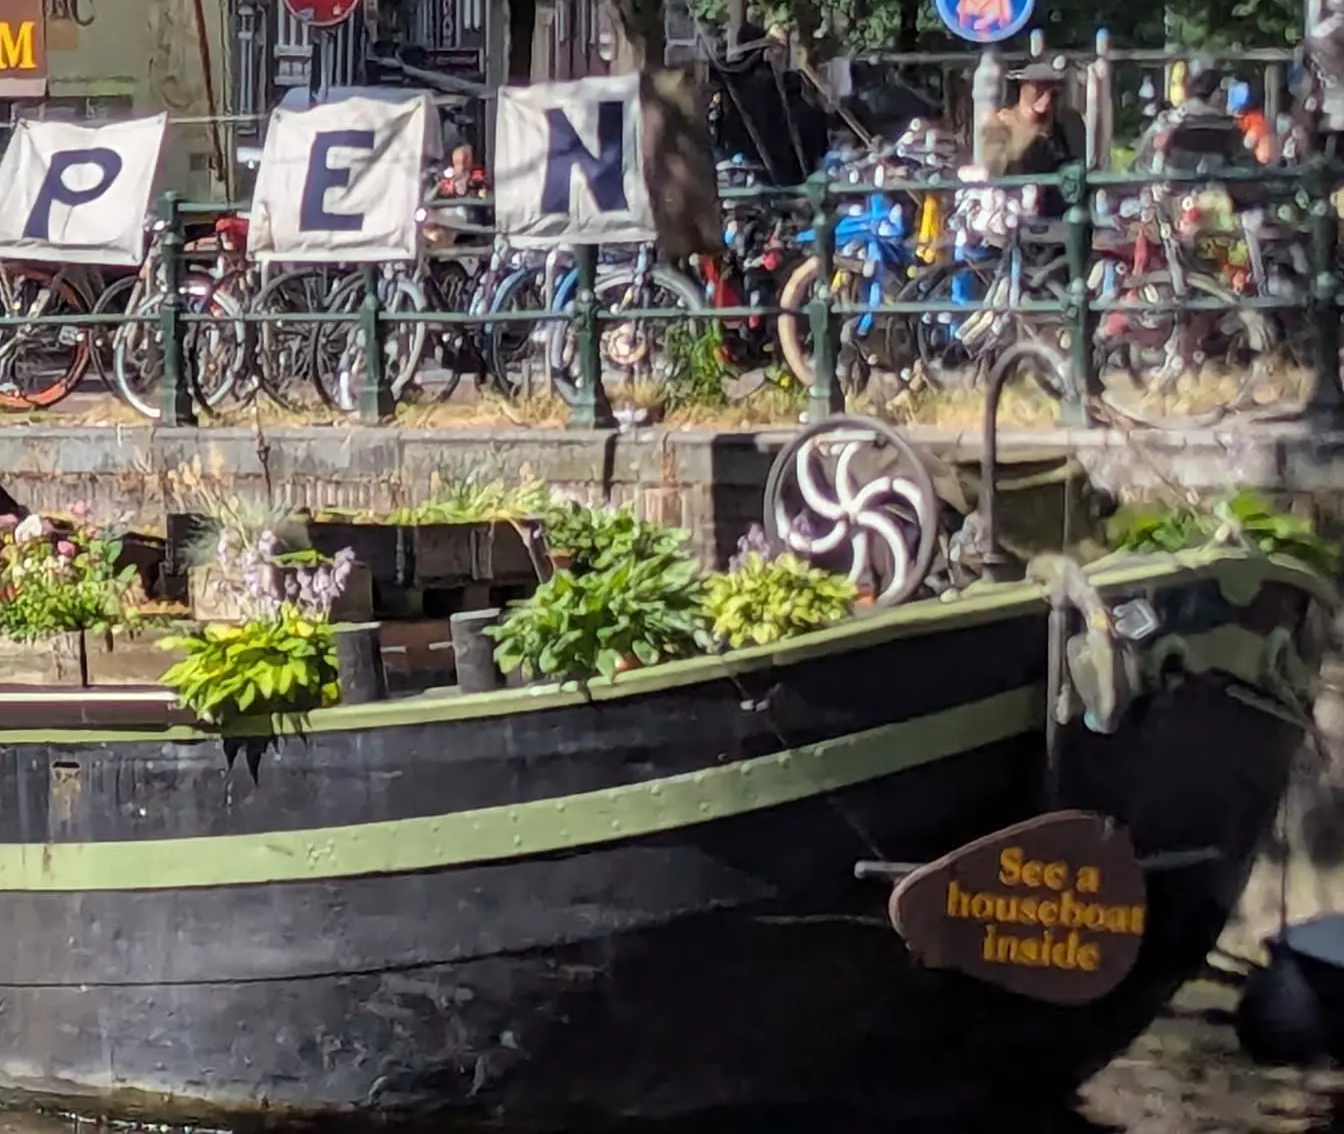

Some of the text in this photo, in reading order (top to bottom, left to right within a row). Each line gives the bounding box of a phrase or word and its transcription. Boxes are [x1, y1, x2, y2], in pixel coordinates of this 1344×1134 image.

[999, 846, 1102, 894] See a
[946, 879, 1146, 935] houseboat
[982, 923, 1100, 972] inside
